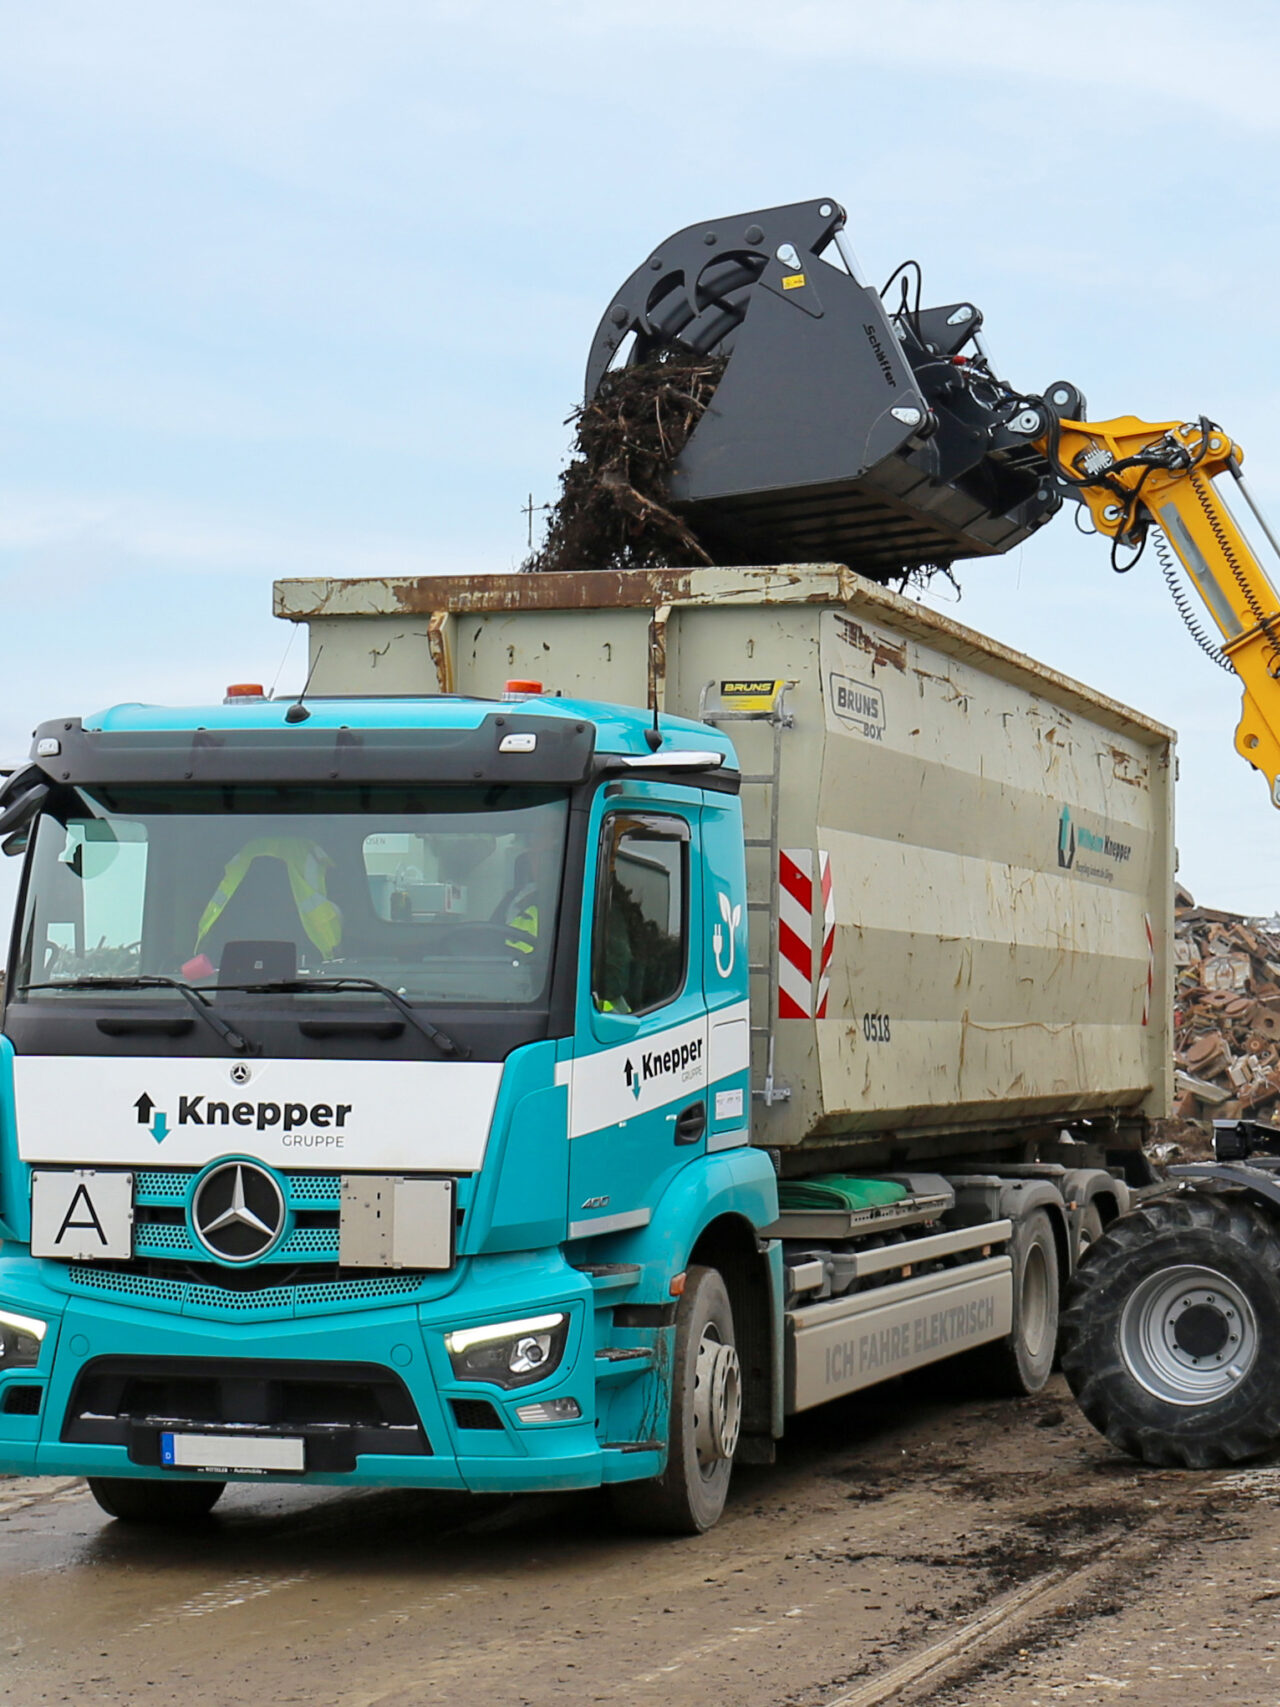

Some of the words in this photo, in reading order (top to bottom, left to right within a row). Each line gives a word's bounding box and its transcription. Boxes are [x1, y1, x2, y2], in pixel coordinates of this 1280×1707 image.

[863, 323, 897, 388] Schäffer
[724, 683, 772, 692] BRUNS
[837, 686, 879, 719] BRUNS
[863, 722, 883, 741] BOX
[1104, 834, 1132, 863] Knepper
[863, 1012, 891, 1043] 0518
[642, 1037, 703, 1081] Knepper
[682, 1065, 703, 1083] GRUPPE
[178, 1095, 352, 1131] Knepper
[281, 1134, 345, 1149] GRUPPE
[54, 1183, 109, 1246] A
[581, 1195, 610, 1209] 400
[825, 1339, 854, 1385] ICH
[859, 1322, 910, 1374] FAHRE
[913, 1295, 995, 1354] ELEKTRISCH
[165, 1451, 172, 1460] D
